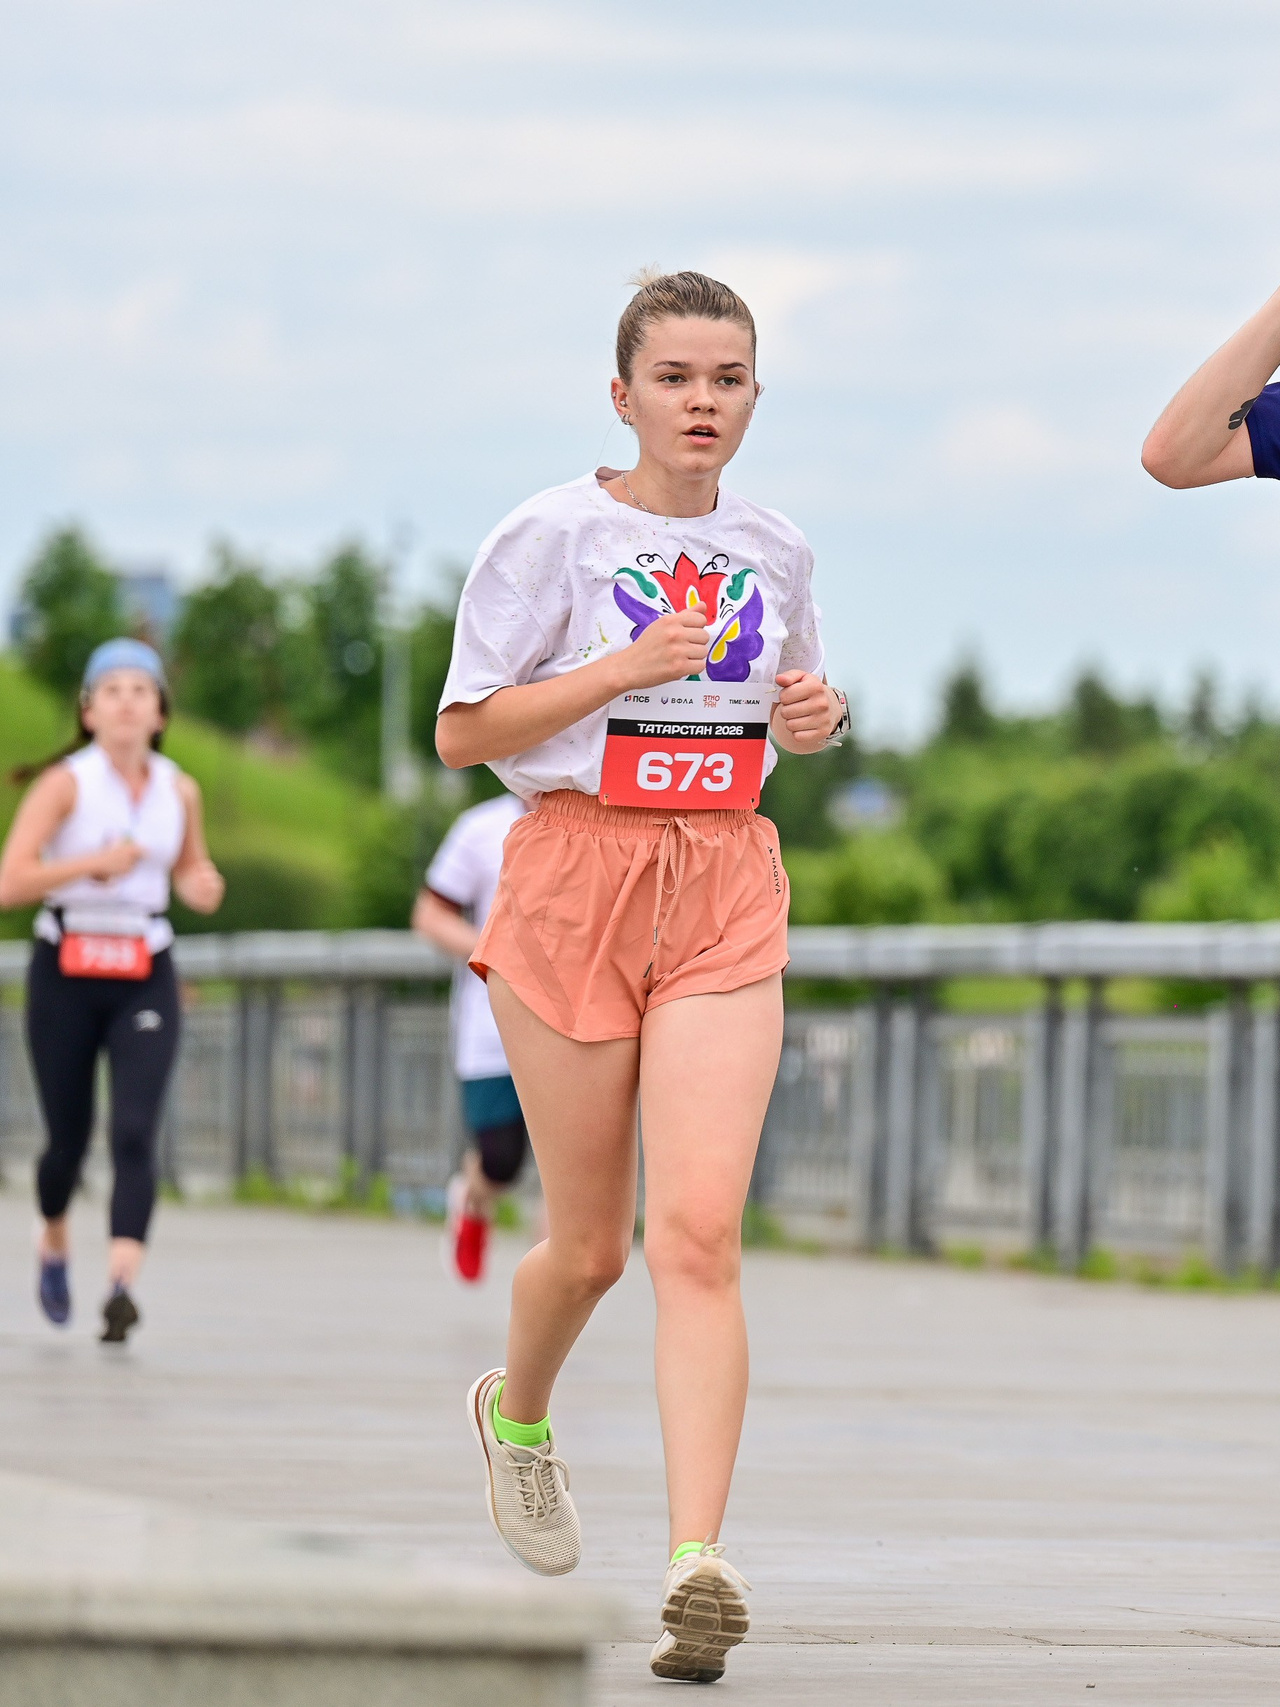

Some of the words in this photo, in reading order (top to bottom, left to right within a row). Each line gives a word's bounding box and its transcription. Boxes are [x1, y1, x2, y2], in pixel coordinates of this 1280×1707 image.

[632, 695, 650, 703] ПСБ
[637, 723, 713, 735] ТАТАРСТАН
[714, 725, 744, 736] 2026
[636, 751, 734, 792] 673
